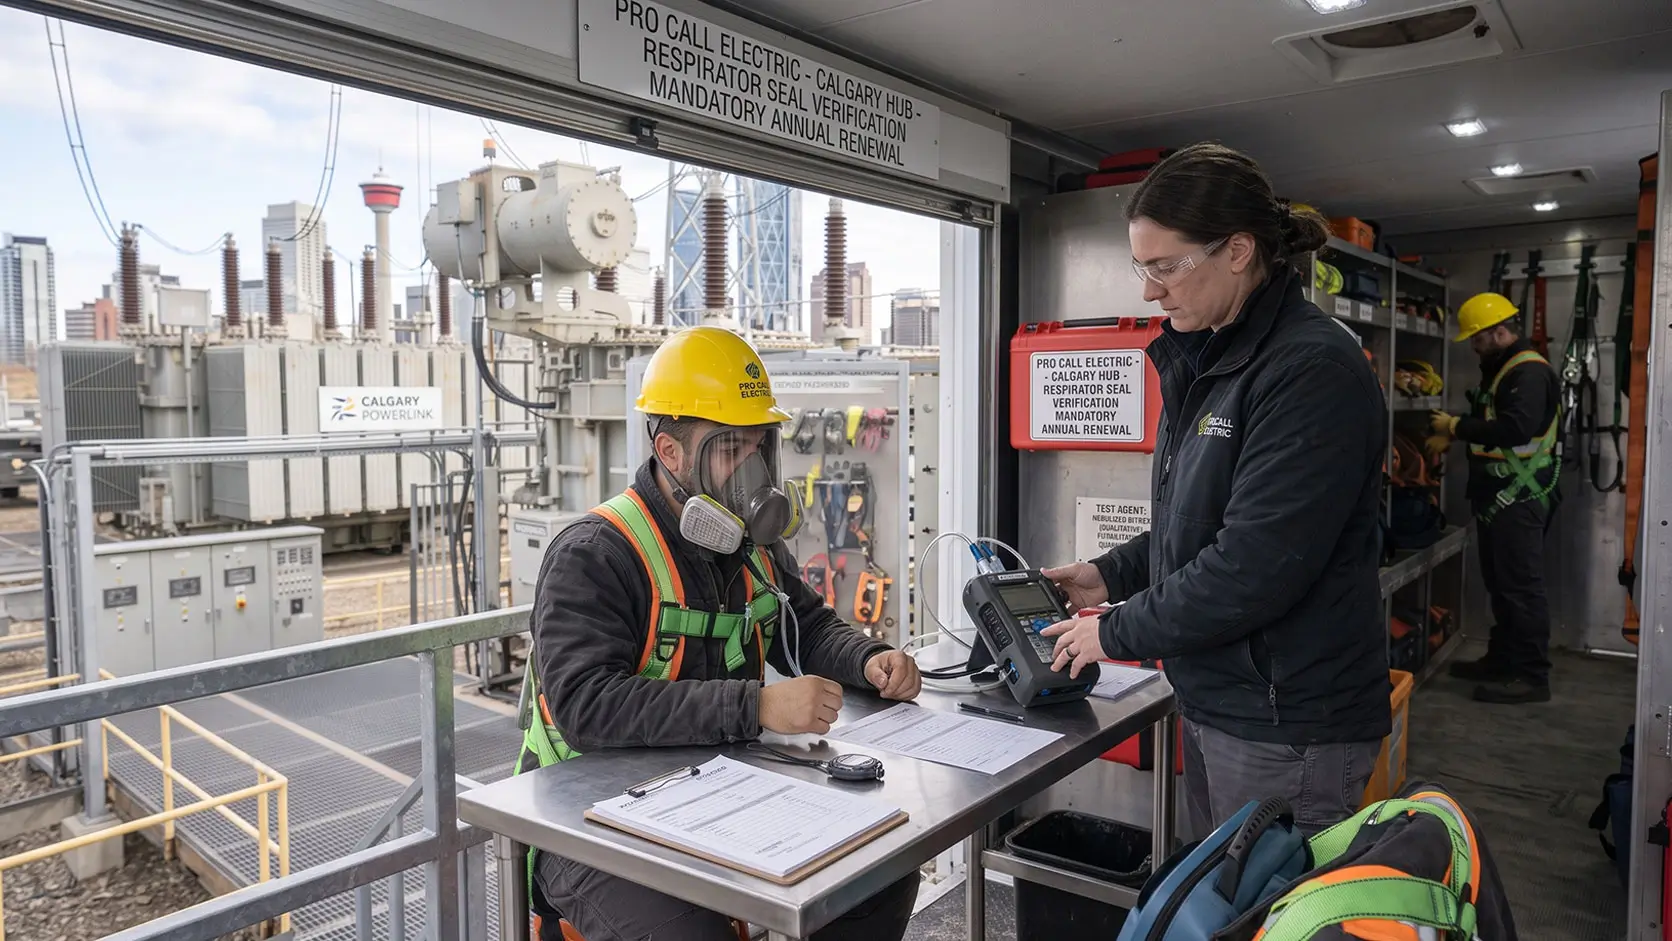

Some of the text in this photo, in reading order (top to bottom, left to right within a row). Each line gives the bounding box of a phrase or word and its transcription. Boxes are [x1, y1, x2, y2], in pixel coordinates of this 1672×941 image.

[615, 0, 659, 33] PRO
[666, 14, 715, 53] CALL
[720, 32, 801, 82] ELECTRIC
[816, 68, 882, 109] CALGARY
[886, 92, 913, 120] HUB
[643, 37, 907, 143] RESPIRATOR SEAL VERIFICATION
[650, 70, 905, 167] MANDATORY ANNUAL RENEWAL
[1037, 358, 1056, 369] PRO
[1059, 357, 1082, 368] CALL
[1085, 356, 1133, 368] ELECTRIC
[1051, 371, 1096, 382] CALGARY
[1098, 370, 1120, 381] HUB
[739, 382, 756, 391] PRO
[1043, 383, 1132, 395] RESPIRATOR SEAL
[361, 396, 420, 407] CALGARY
[1052, 397, 1119, 408] VERIFICATION
[362, 408, 433, 421] POWERLINK
[1055, 410, 1117, 422] MANDATORY
[1041, 424, 1132, 436] ANNUAL RENEWAL
[1096, 504, 1147, 515] TEST AGENT:
